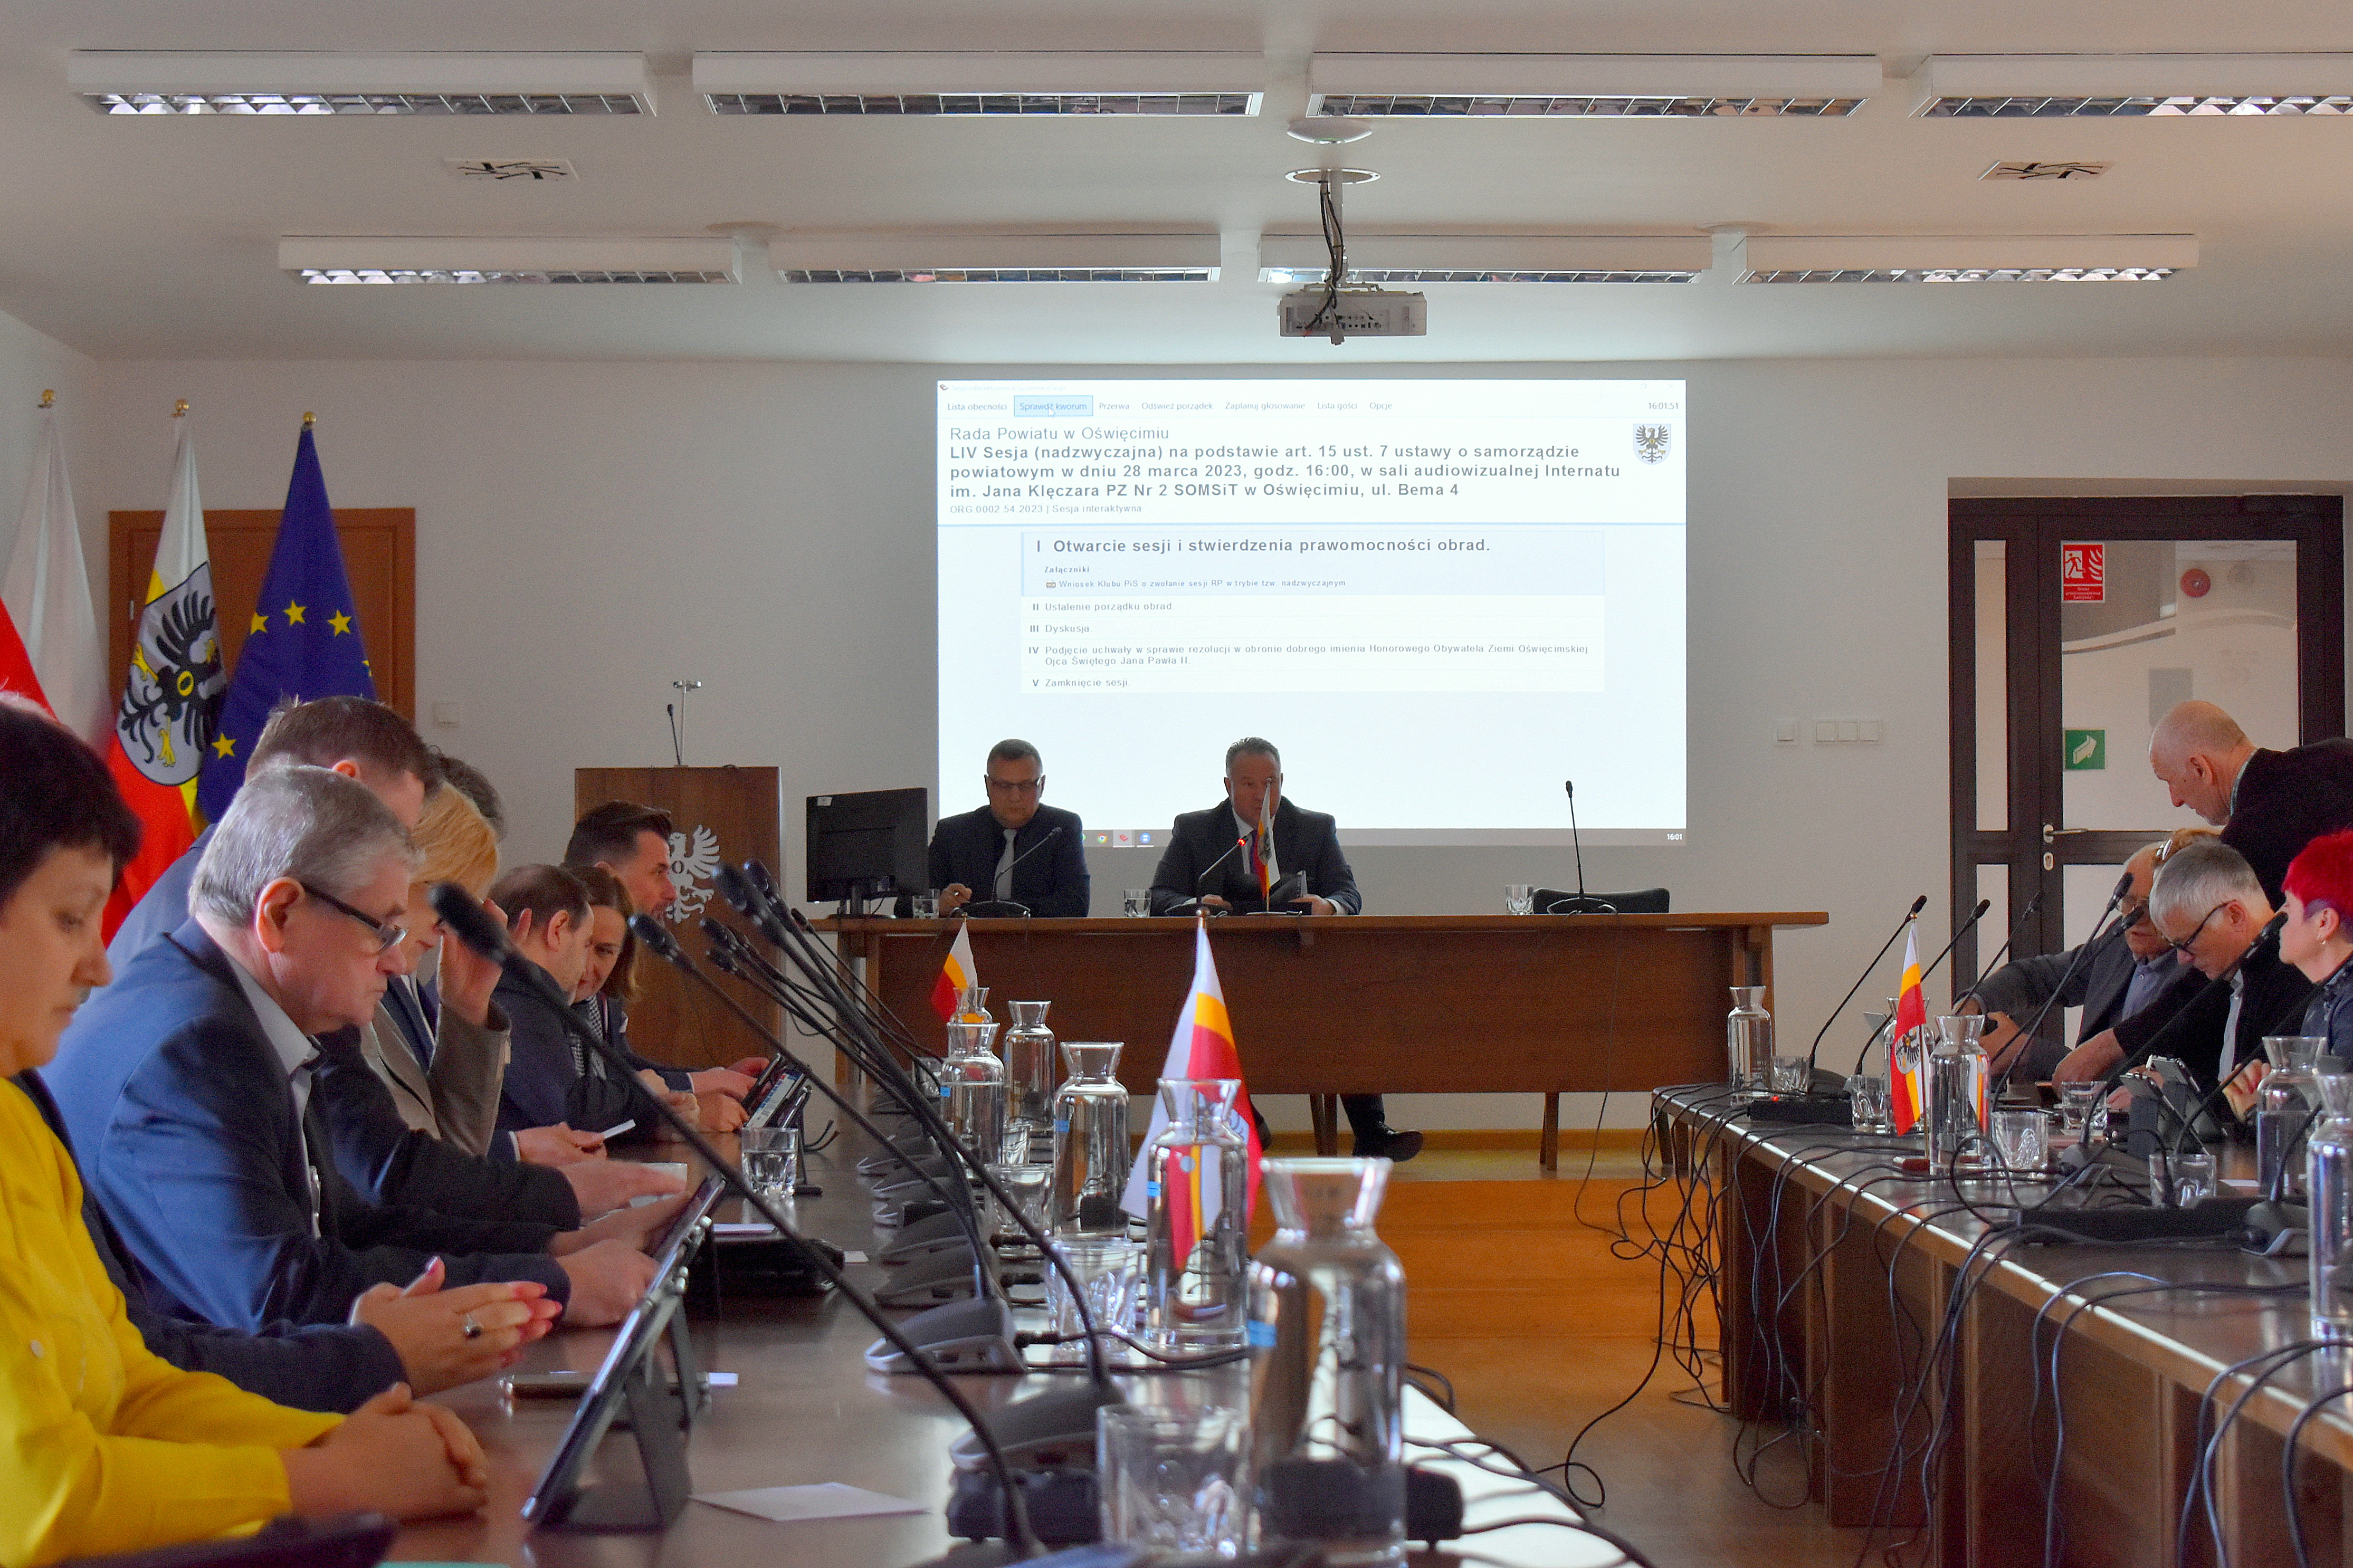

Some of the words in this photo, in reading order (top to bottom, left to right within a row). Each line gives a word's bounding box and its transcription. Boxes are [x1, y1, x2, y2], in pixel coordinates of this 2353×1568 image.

[1055, 401, 1088, 412] kworum
[1177, 402, 1214, 411] porządek
[1225, 401, 1260, 411] Zaplanuj
[1261, 402, 1306, 411] głosowanie
[1337, 402, 1357, 411] gości
[1369, 401, 1393, 411] Opcje
[1648, 401, 1679, 410] 16:01:51
[950, 427, 990, 440] Rada
[998, 427, 1058, 440] Powiatu
[1063, 430, 1075, 439] w
[1081, 427, 1169, 442] Oświęcimiu
[950, 446, 977, 459] LIV
[983, 446, 1028, 462] Sesja
[1034, 445, 1163, 461] (nadzwyczajna)
[1169, 448, 1188, 458] na
[1195, 445, 1279, 461] podstawie
[1285, 445, 1312, 457] art.
[1319, 445, 1337, 457] 15
[1343, 445, 1373, 457] ust.
[1379, 445, 1388, 457] 7
[1395, 445, 1452, 460] ustawy
[1458, 448, 1468, 457] o
[1474, 445, 1579, 461] samorządzie
[950, 465, 1054, 481] powiatowym
[1061, 468, 1074, 477] w
[1080, 465, 1116, 477] dniu
[1123, 464, 1141, 477] 28
[1148, 467, 1198, 477] marca
[1205, 464, 1246, 479] 2023,
[1254, 464, 1298, 480] godz.
[1306, 464, 1354, 479] 16:00,
[1360, 467, 1373, 476] w
[1379, 464, 1407, 476] sali
[1414, 464, 1538, 480] audiowizualnej
[1546, 464, 1620, 477] Internatu
[950, 485, 976, 498] im.
[982, 485, 1021, 497] Jana
[1028, 484, 1099, 500] Klęczara
[1107, 484, 1128, 496] PZ
[1134, 484, 1153, 496] Nr
[1159, 484, 1167, 496] 2
[1174, 483, 1239, 496] SOMSiT
[1244, 486, 1257, 496] w
[1263, 483, 1364, 499] Oświęcimiu,
[1371, 483, 1391, 495] ul.
[1398, 483, 1444, 495] Bema
[1450, 483, 1459, 495] 4
[1052, 504, 1079, 514] Sesja
[1082, 504, 1142, 514] interaktywna
[1054, 539, 1127, 552] Otwarcie
[1132, 539, 1171, 554] sesji
[1178, 539, 1182, 551] i
[1188, 539, 1292, 551] stwierdzenia
[1300, 538, 1431, 554] prawomocności
[1437, 539, 1491, 551] obrad.
[1044, 566, 1090, 575] Załączniki
[1235, 579, 1259, 588] trybie
[1282, 579, 1346, 588] nadzwyczajnym
[1094, 603, 1140, 612] porządku
[1045, 646, 1088, 656] Podjęcie
[1092, 645, 1132, 655] uchwały
[1189, 645, 1230, 655] rezolucji
[1286, 645, 1326, 654] dobrego
[1369, 644, 1430, 654] Honorowego
[1433, 644, 1484, 654] Obywatela
[1488, 644, 1514, 653] Ziemi
[1518, 644, 1588, 655] Oświęcimskiej
[1045, 657, 1068, 667] Ojca
[1072, 655, 1116, 667] Świętego
[1045, 678, 1102, 689] Zamknięcie
